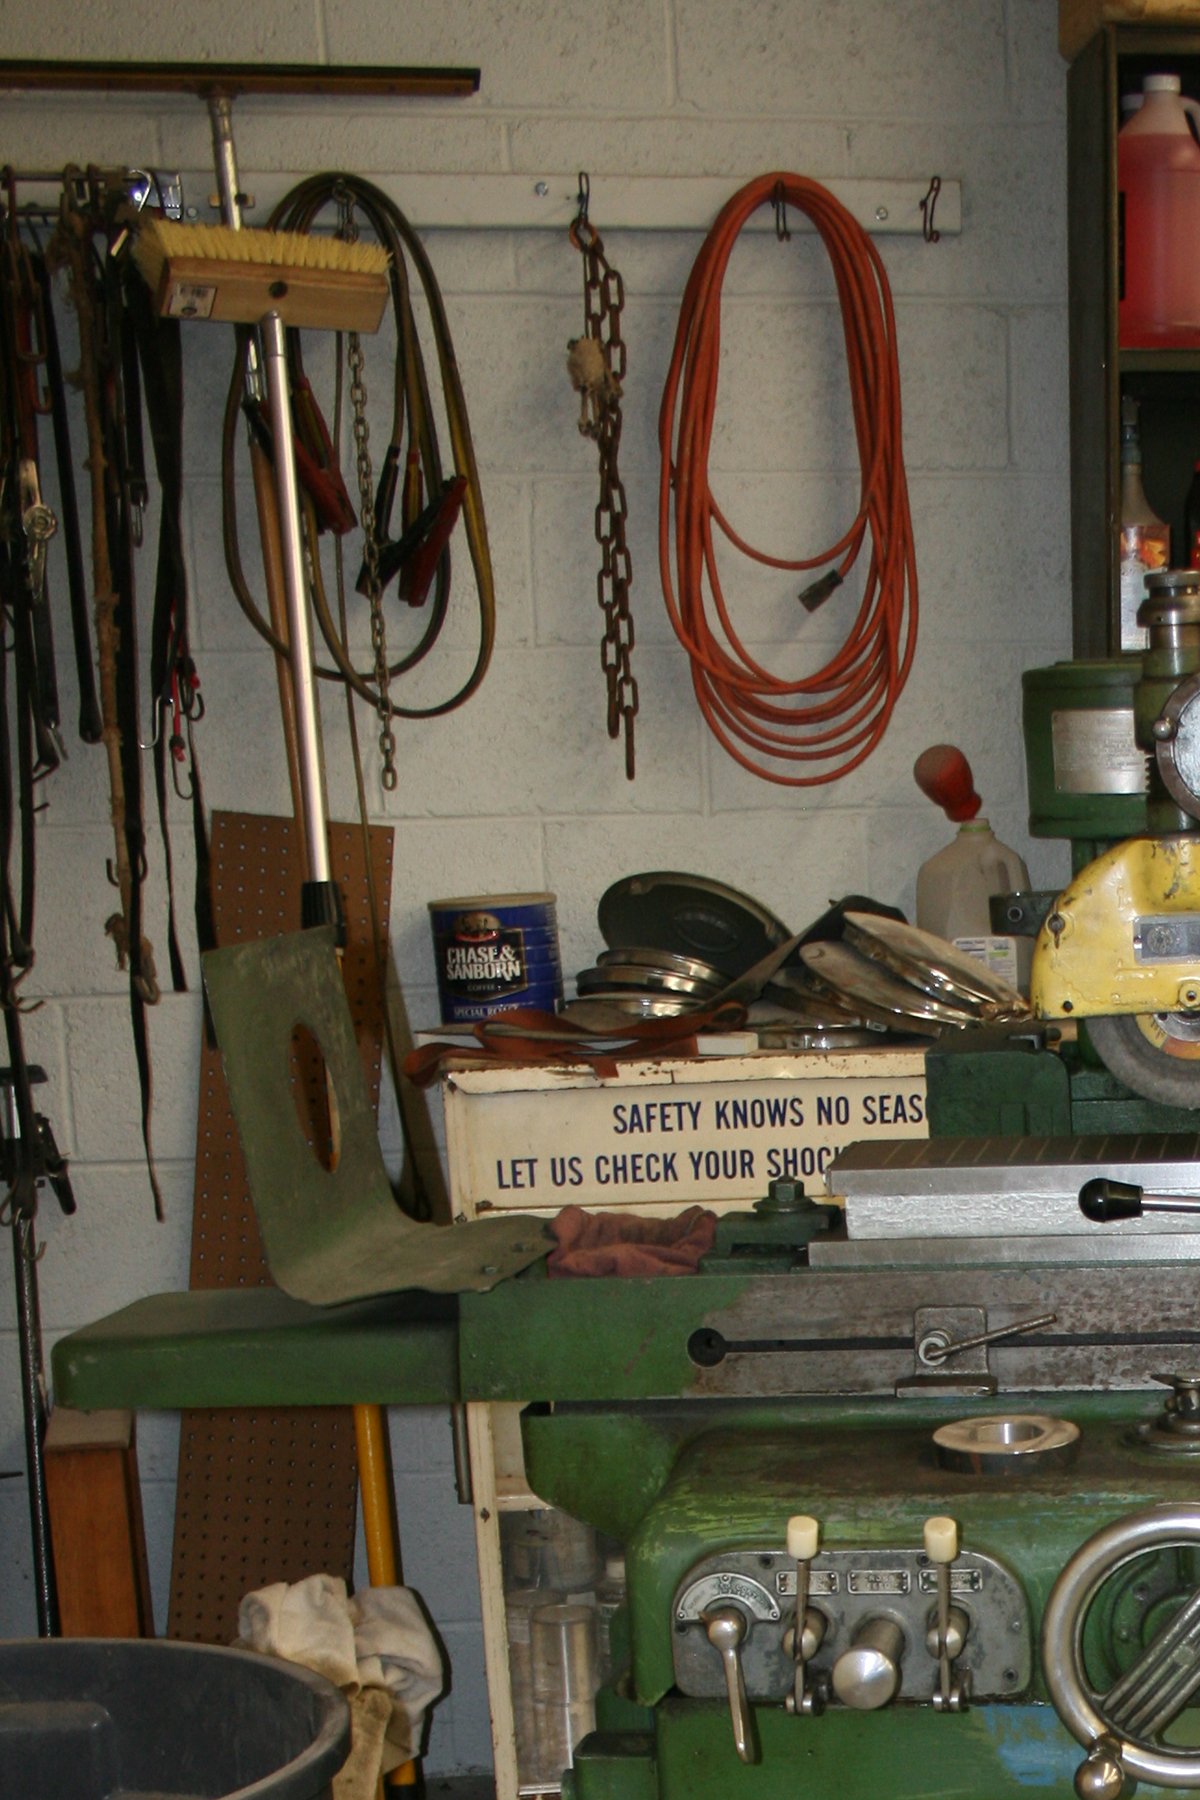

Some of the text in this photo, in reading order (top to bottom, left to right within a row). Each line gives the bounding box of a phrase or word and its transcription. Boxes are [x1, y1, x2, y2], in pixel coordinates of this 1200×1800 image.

[446, 960, 521, 981] SANBORN
[613, 1094, 929, 1135] SAFETY KNOWS NO SEAS
[497, 1158, 538, 1190] LET
[550, 1156, 583, 1187] US
[595, 1152, 678, 1184] CHECK
[689, 1149, 755, 1181] YOUR
